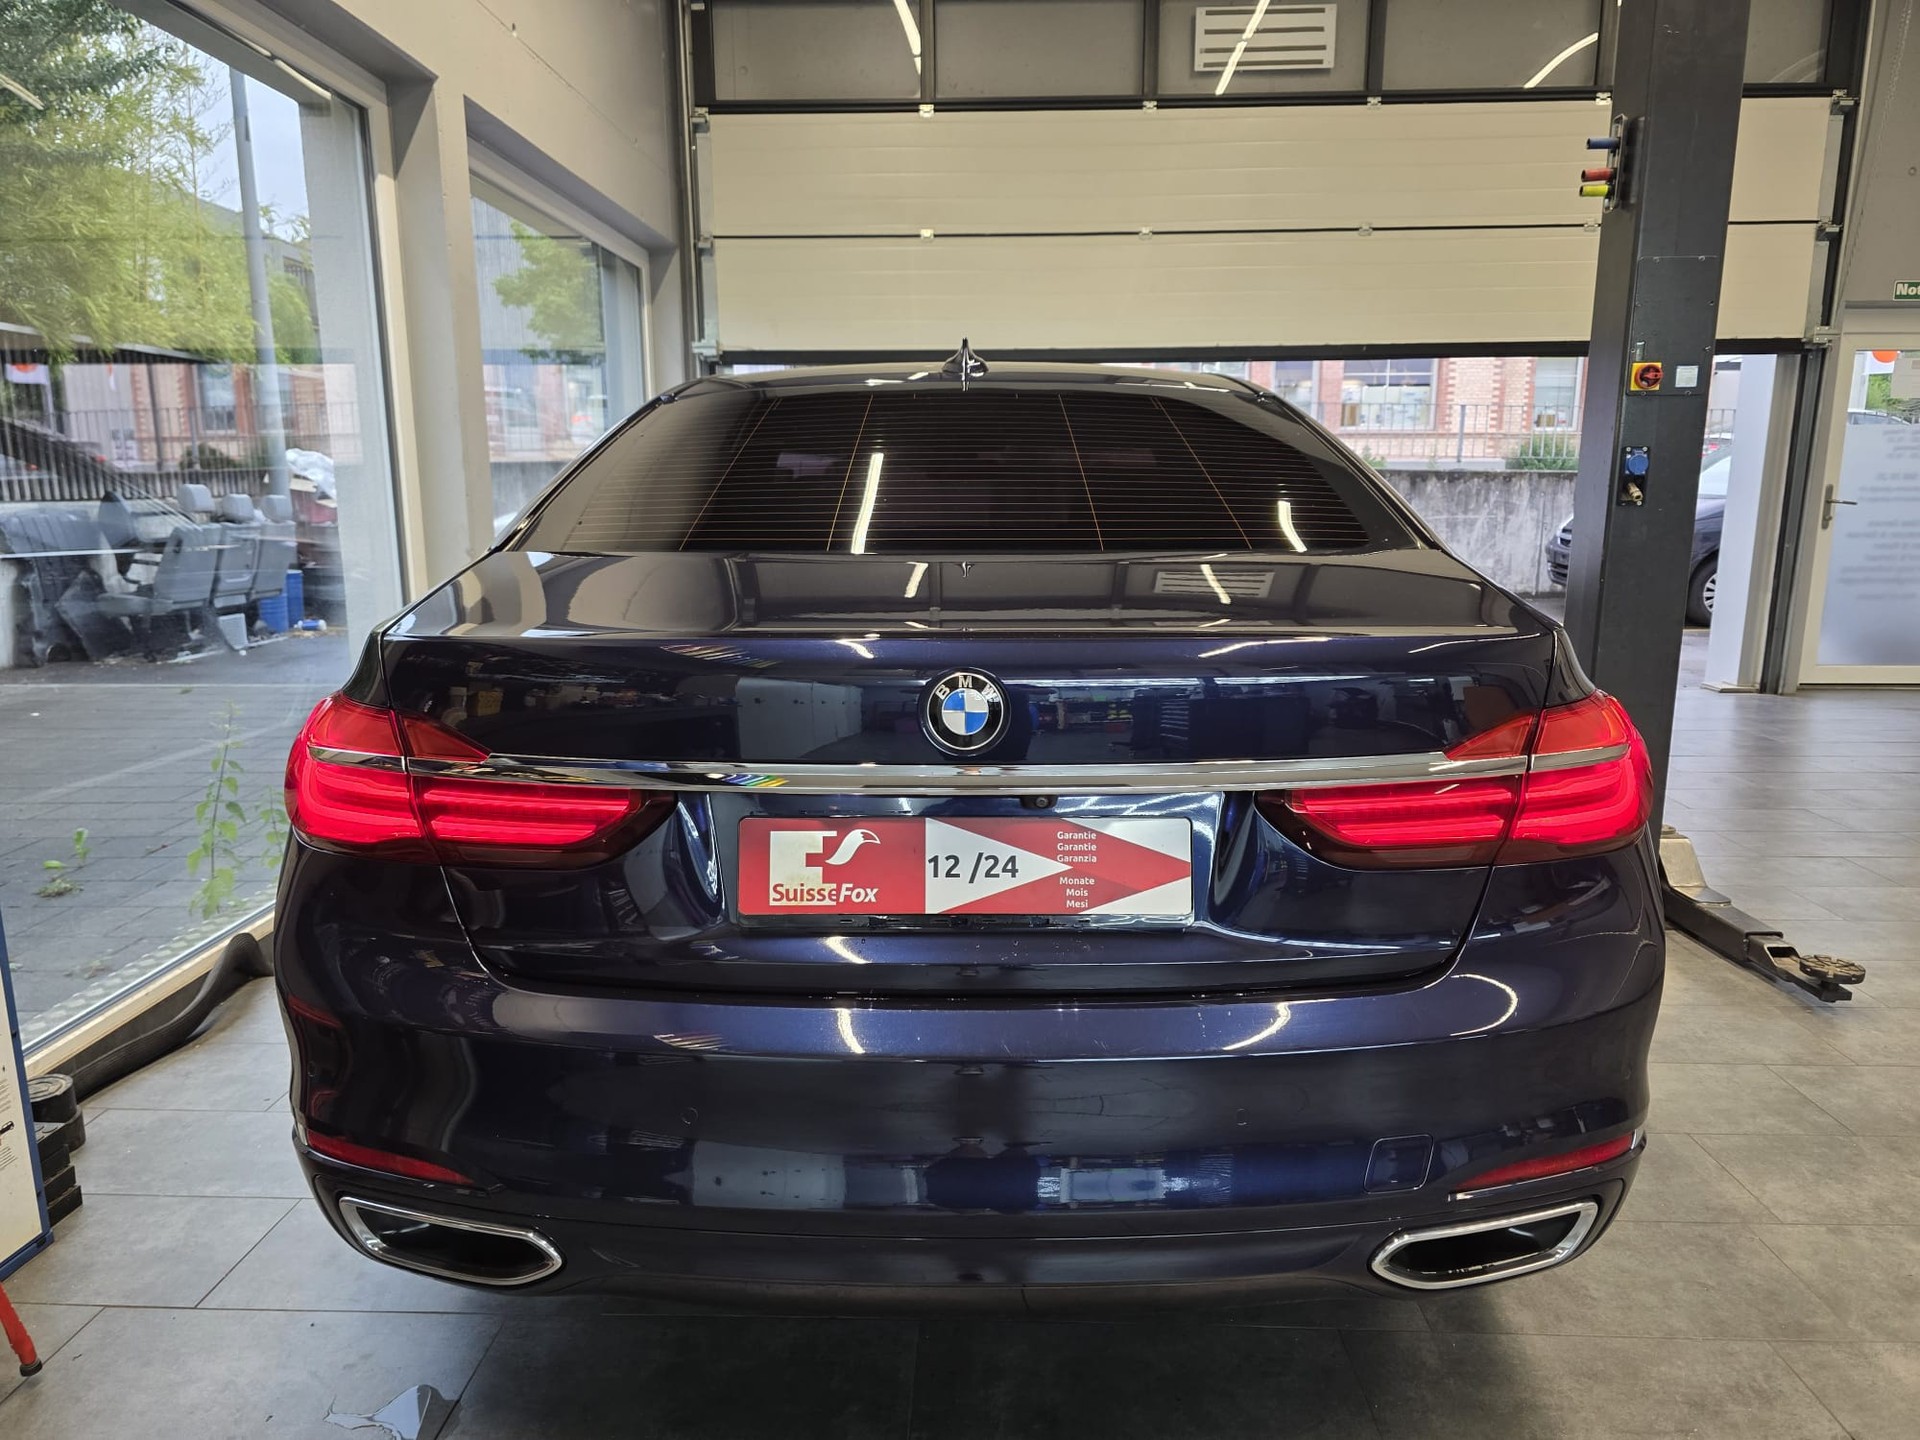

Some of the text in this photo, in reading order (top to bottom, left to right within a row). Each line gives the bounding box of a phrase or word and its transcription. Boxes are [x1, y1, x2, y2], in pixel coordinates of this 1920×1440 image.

[935, 675, 1000, 703] BMW
[1057, 831, 1097, 840] Garantie
[1057, 842, 1097, 851] Garantie
[1057, 854, 1097, 863] Garanzia
[1059, 877, 1095, 885] Monate
[772, 883, 879, 903] SuisseFox
[1066, 888, 1089, 897] Mois
[1066, 899, 1089, 908] Mesi
